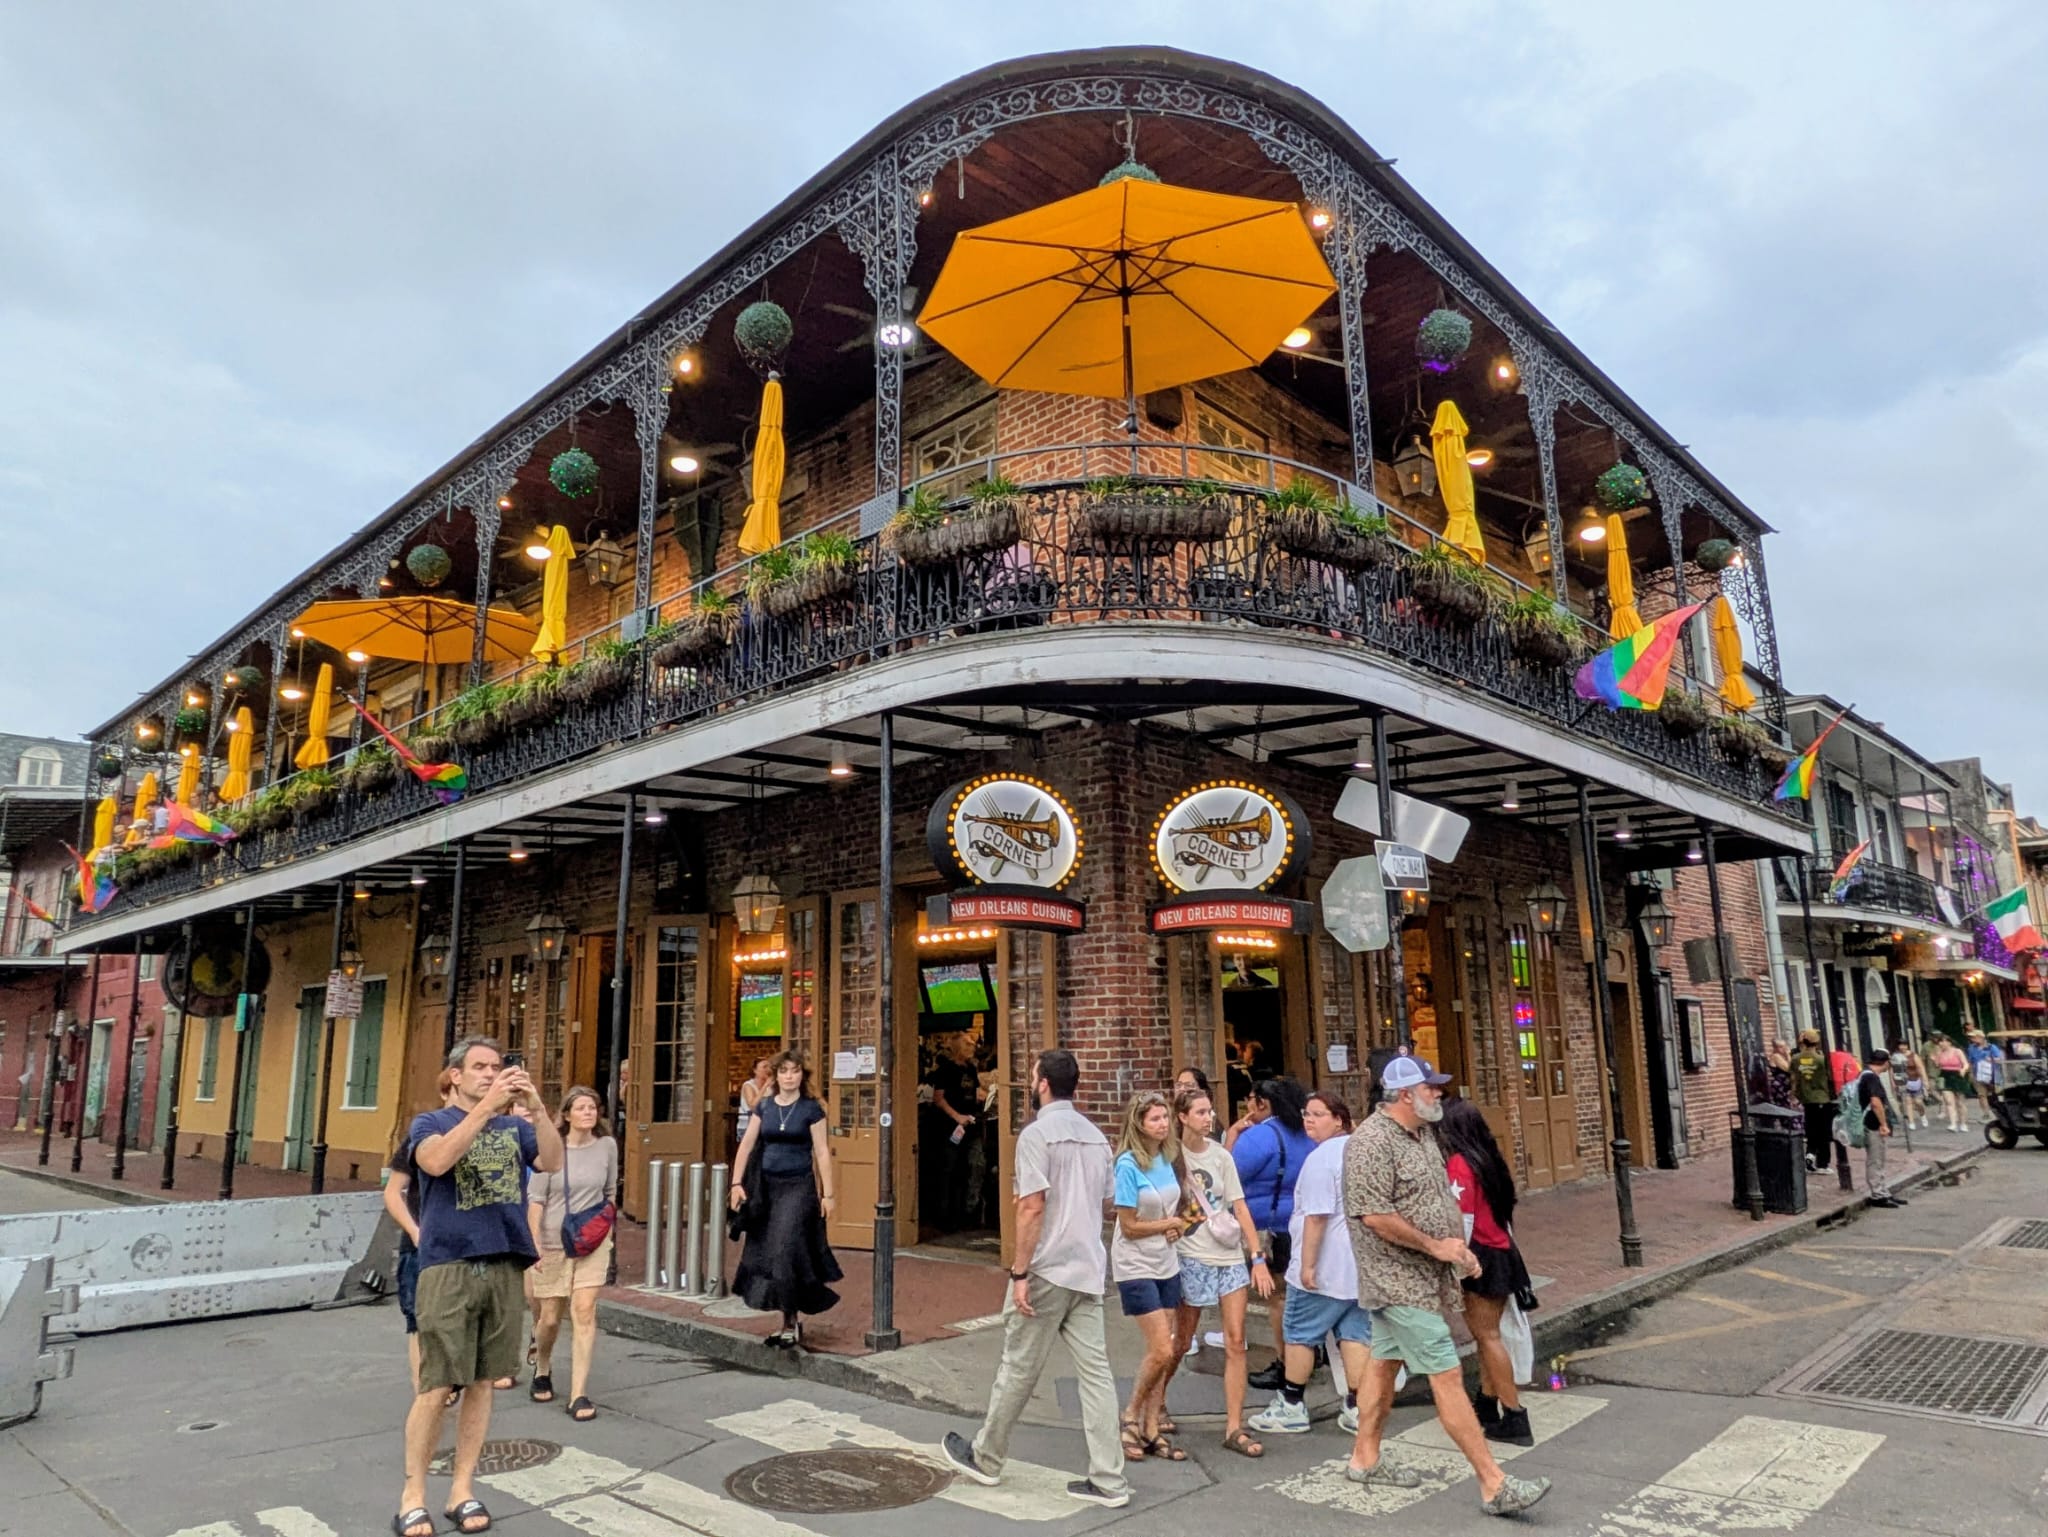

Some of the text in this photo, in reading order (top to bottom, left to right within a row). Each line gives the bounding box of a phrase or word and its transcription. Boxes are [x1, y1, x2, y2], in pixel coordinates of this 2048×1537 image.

[982, 825, 1042, 869] CORNET
[1187, 835, 1251, 869] CORNET
[1393, 857, 1422, 876] ONE WAY
[950, 900, 1073, 923] NEW ORLEANS CUISINE
[1159, 903, 1289, 926] NEW ORLEANS CUISINE
